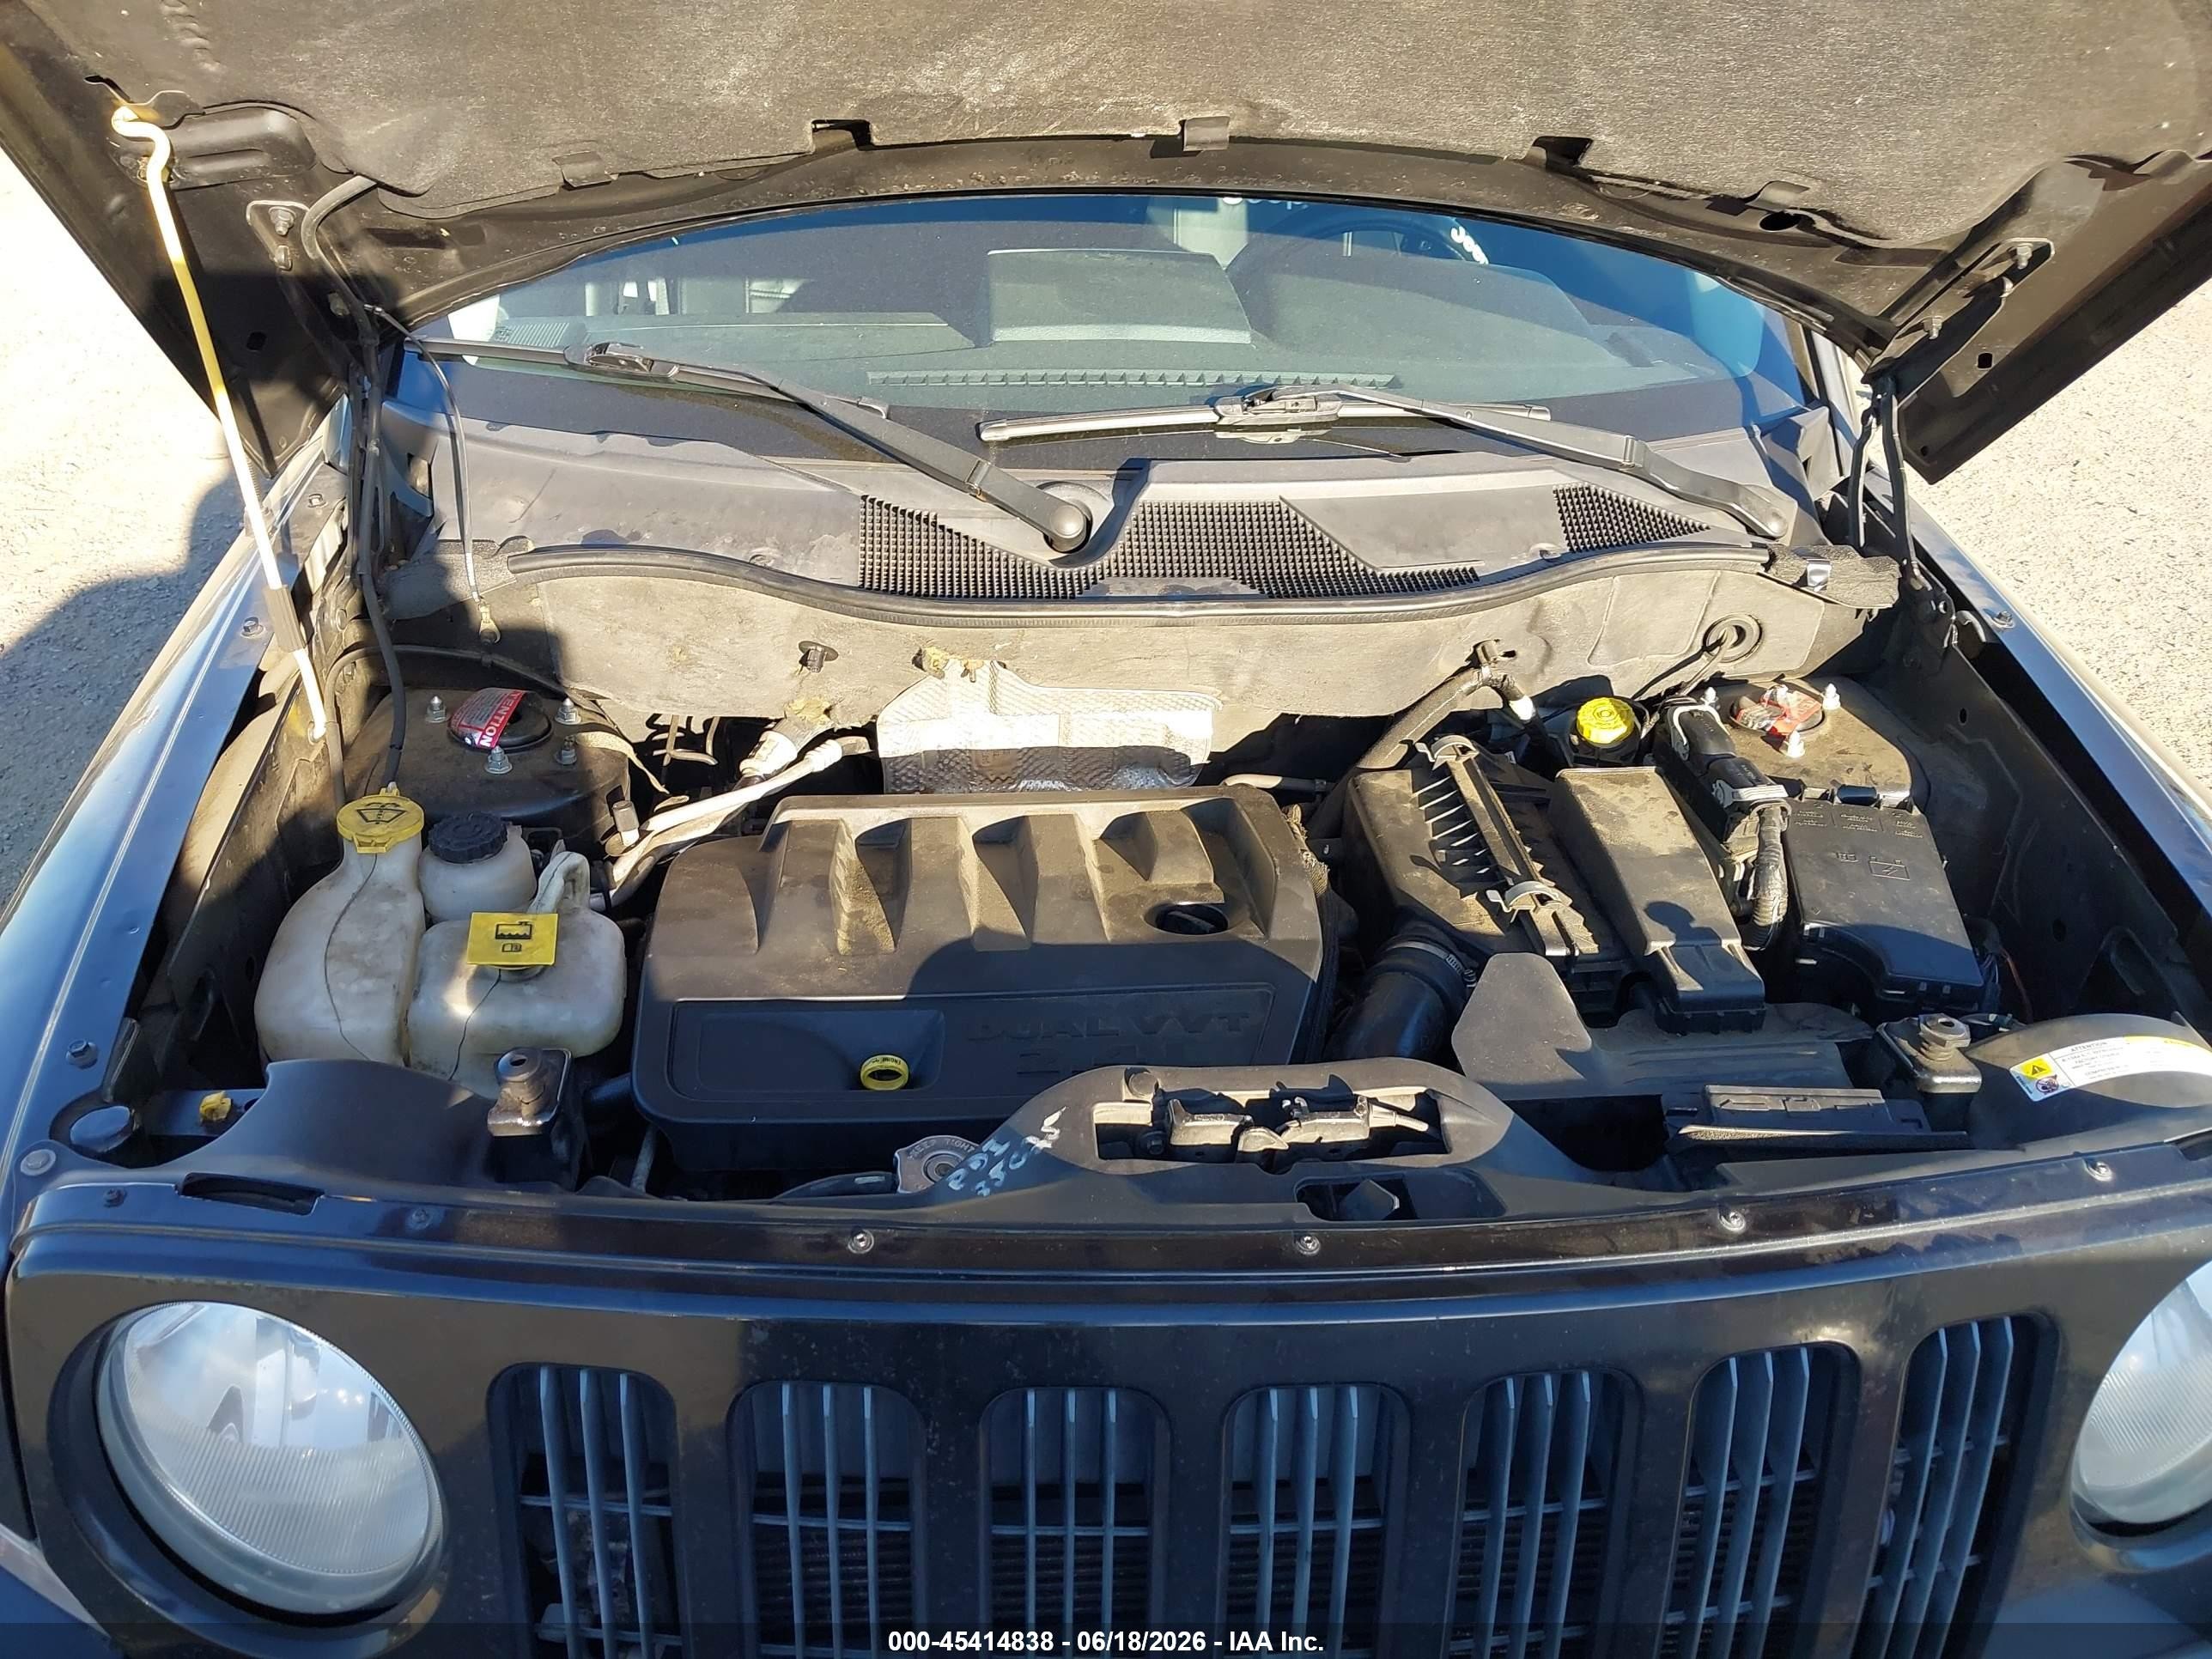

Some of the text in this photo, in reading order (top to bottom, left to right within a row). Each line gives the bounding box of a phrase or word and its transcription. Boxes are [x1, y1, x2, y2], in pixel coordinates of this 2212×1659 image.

[480, 690, 522, 747] TENTION
[968, 1010, 1250, 1042] DUAL VVT
[2069, 1040, 2108, 1053] ATTENTION
[882, 1057, 902, 1066] ENGINE
[908, 1138, 975, 1158] KEEP TIGHT
